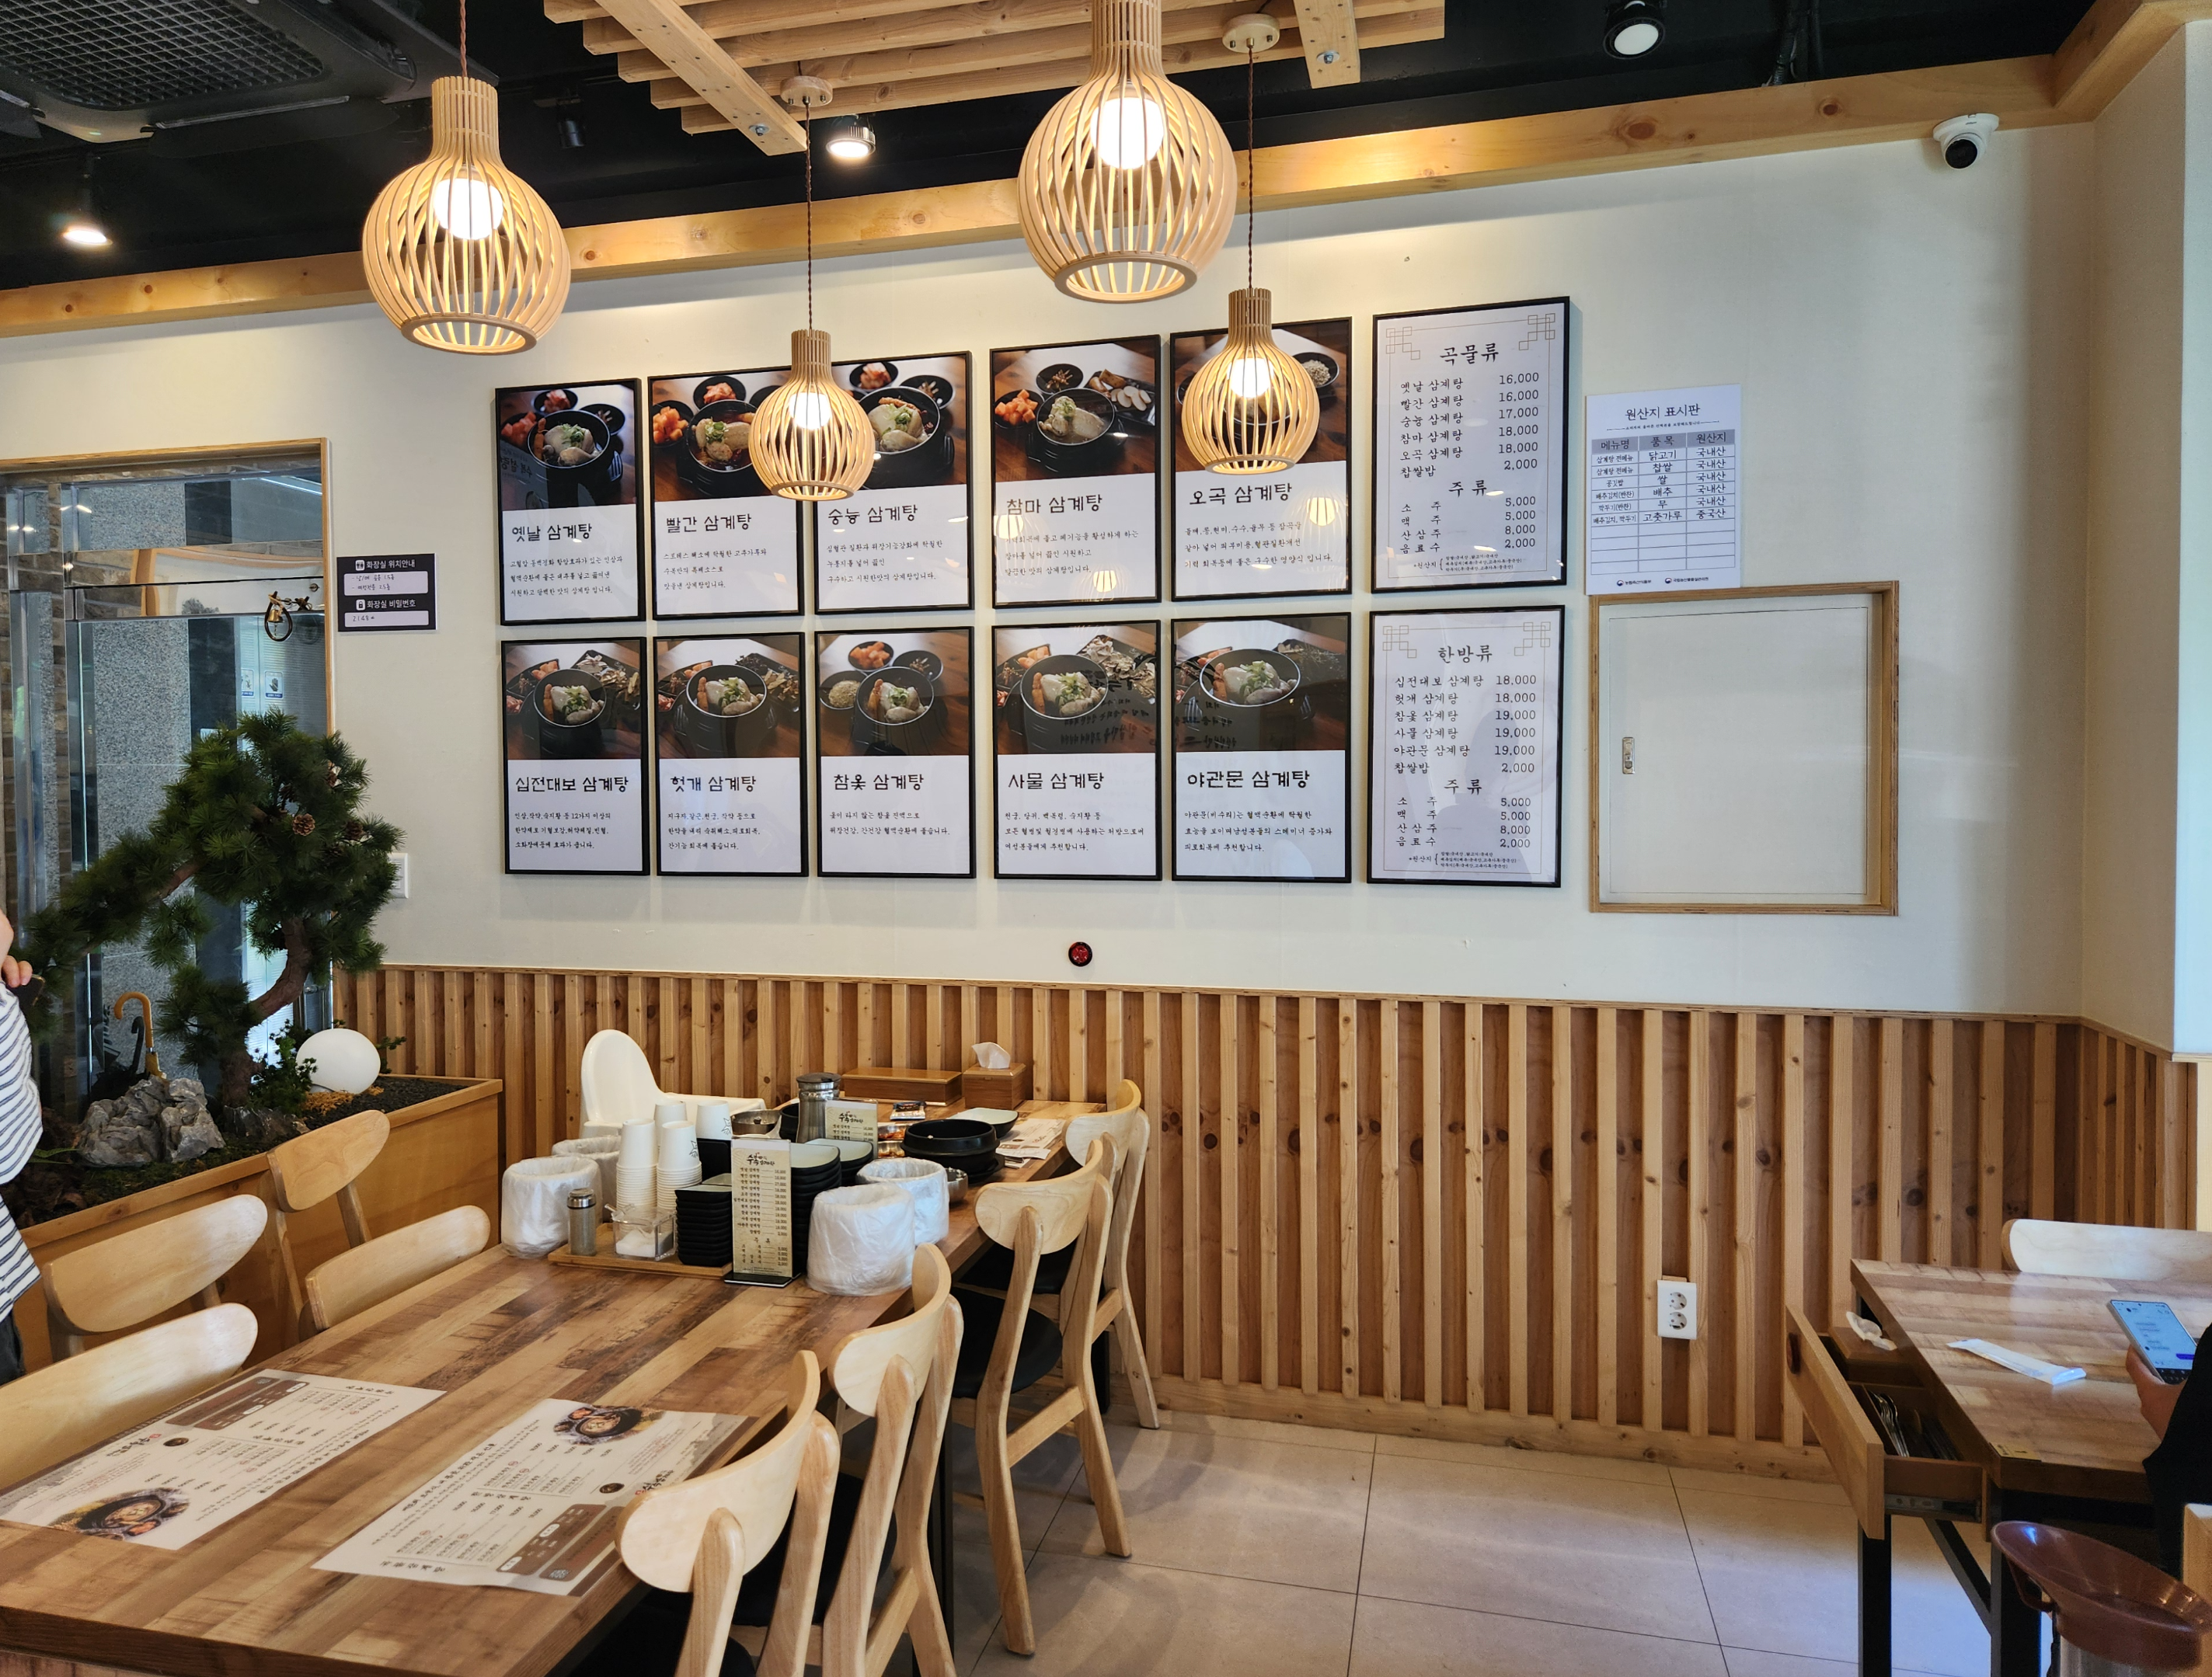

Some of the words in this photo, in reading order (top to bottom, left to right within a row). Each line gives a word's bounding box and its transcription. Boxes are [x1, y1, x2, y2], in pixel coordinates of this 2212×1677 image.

[1440, 343, 1499, 366] 곡물류
[1401, 381, 1423, 394] 옛날
[1429, 378, 1463, 391] 삼계탕
[1499, 372, 1539, 384] 16,000
[1401, 398, 1423, 411] 빨간
[1428, 395, 1463, 409] 삼계탕
[1499, 390, 1539, 402] 16,000
[1401, 416, 1423, 427] 숭늉
[1428, 412, 1463, 426] 삼계탕
[1499, 407, 1538, 419] 17,000
[1625, 406, 1660, 421] 원산지
[1664, 404, 1700, 417] 표시판
[1401, 432, 1423, 444] 참마
[1427, 430, 1462, 444] 삼계탕
[1499, 425, 1538, 437] 18,000
[1601, 439, 1629, 451] 메뉴명
[1696, 432, 1726, 444] 원산지
[1400, 450, 1423, 461] 오곡
[1427, 447, 1462, 461] 삼계탕
[1499, 442, 1538, 454] 18,000
[1649, 451, 1677, 461] 닭고기
[1696, 447, 1726, 458] 국내산
[1401, 465, 1436, 478] 찹쌀밥
[1504, 458, 1538, 471] 2,000
[1653, 462, 1673, 473] 찹쌀
[1696, 459, 1726, 469] 국내산
[1657, 475, 1667, 485] 쌀
[1696, 471, 1726, 482] 국내산
[1190, 488, 1226, 505] 오곡
[1235, 483, 1292, 503] 삼계탕
[1653, 487, 1673, 497] 배추
[1696, 484, 1726, 494] 국내산
[1007, 499, 1041, 515] 참마
[1049, 494, 1103, 513] 삼계탕
[1505, 496, 1536, 507] 5,000
[1658, 500, 1667, 509] 무
[1696, 496, 1726, 506] 국내산
[828, 508, 860, 525] 숭늉
[868, 504, 918, 523] 삼계탕
[1505, 510, 1536, 520] 5,000
[1696, 508, 1726, 520] 중국산
[667, 516, 698, 533] 빨간
[704, 513, 751, 531] 삼계탕
[1505, 524, 1535, 535] 8,000
[512, 526, 541, 542] 옛날
[547, 524, 592, 540] 삼계탕
[1505, 538, 1535, 549] 2,000
[388, 559, 415, 569] 위치안내
[367, 600, 387, 609] 화장실
[1438, 645, 1493, 663] 한방류
[1395, 677, 1443, 687] 십전대보
[1447, 675, 1484, 687] 삼계탕
[1496, 675, 1536, 686] 18,000
[1395, 694, 1416, 705] 헛개
[1423, 693, 1458, 705] 삼계탕
[1496, 693, 1536, 703] 18,000
[1395, 711, 1417, 722] 참옻
[1423, 711, 1458, 722] 삼계탕
[1496, 710, 1535, 721] 19,000
[1395, 729, 1417, 739] 사물
[1423, 728, 1458, 739] 삼계탕
[1495, 728, 1535, 738] 19,000
[1394, 746, 1429, 757] 야관문
[1434, 745, 1470, 757] 삼계탕
[1494, 745, 1534, 756] 19,000
[1395, 762, 1430, 774] 찹쌀밥
[1501, 763, 1534, 773] 2,000
[515, 777, 577, 792] 십전대보
[583, 777, 629, 792] 삼계탕
[671, 776, 701, 792] 헛개
[709, 776, 756, 792] 삼계탕
[834, 774, 866, 790] 참옻
[873, 774, 924, 791] 삼계탕
[1008, 772, 1043, 789] 사물
[1050, 772, 1104, 789] 삼계탕
[1188, 771, 1244, 788] 야관문
[1252, 771, 1310, 788] 삼계탕
[1500, 798, 1531, 808] 5,000
[1500, 812, 1531, 821] 5,000
[1500, 825, 1531, 835] 8,000
[1500, 839, 1531, 848] 2,000
